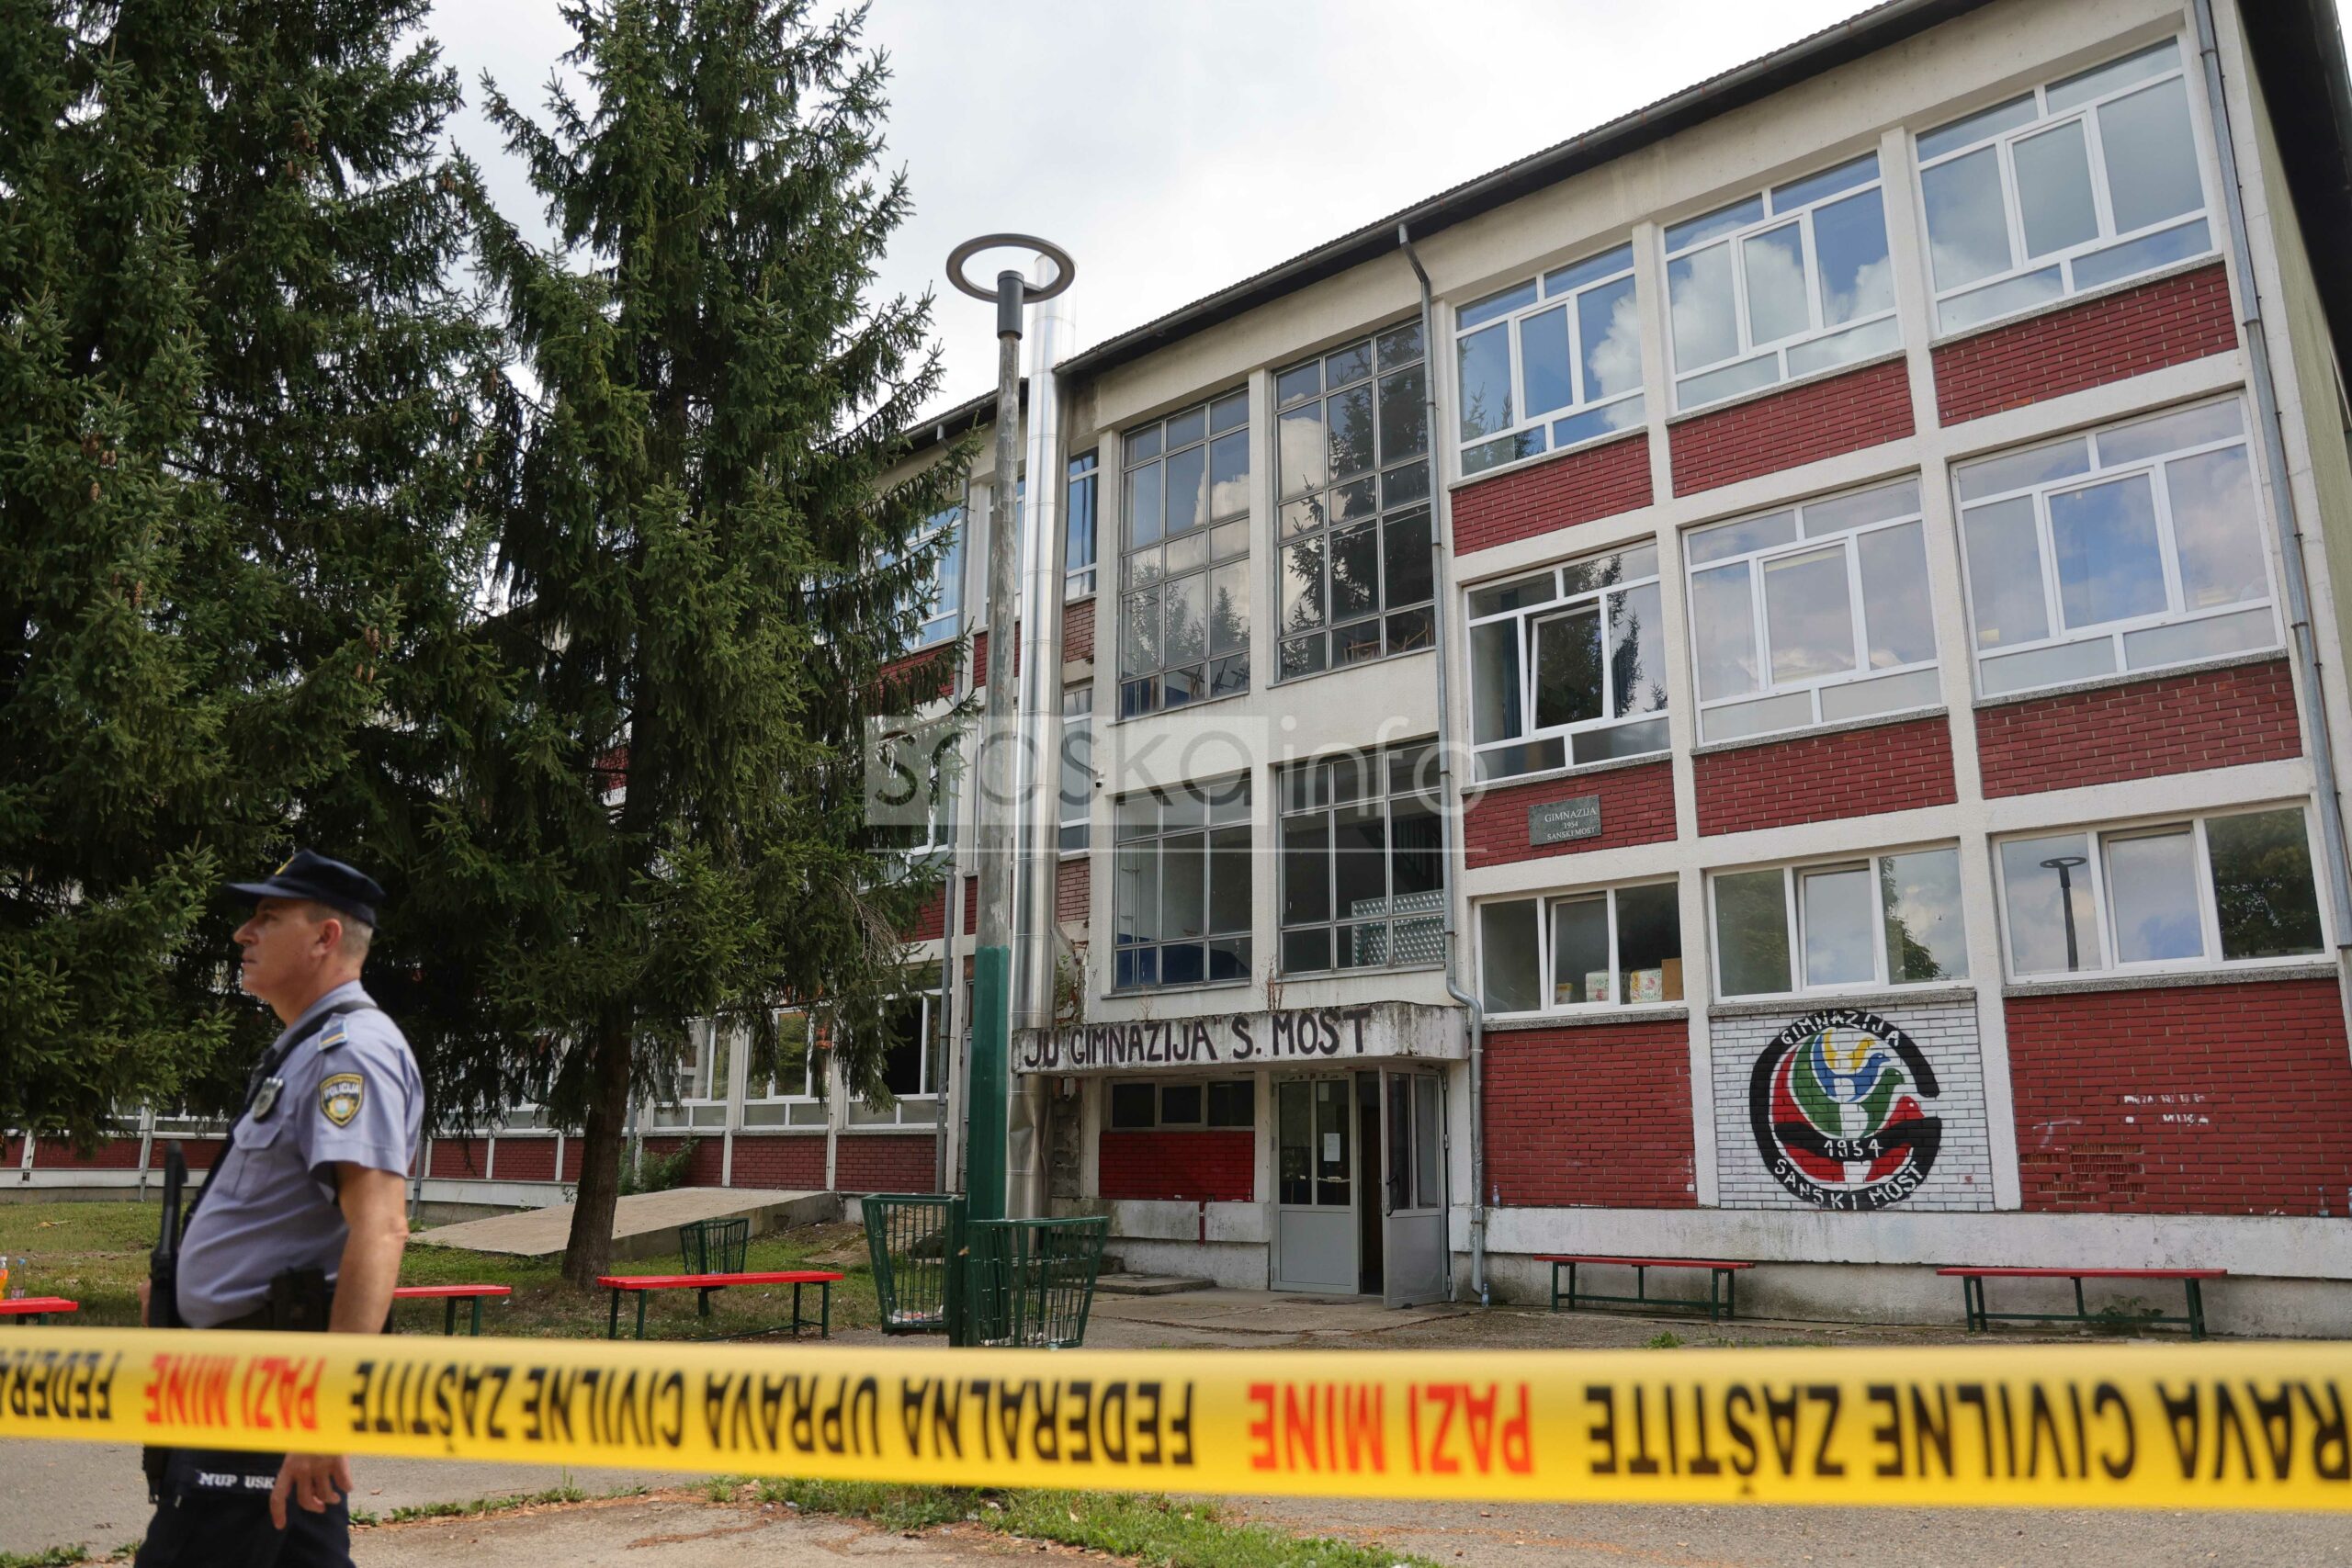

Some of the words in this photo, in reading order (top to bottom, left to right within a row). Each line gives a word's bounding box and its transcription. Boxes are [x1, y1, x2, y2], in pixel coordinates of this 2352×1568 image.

[1544, 807, 1597, 822] GIMNAZIJA
[1546, 829, 1574, 840] SANSKI
[1575, 827, 1596, 836] MOST
[1564, 821, 1578, 829] 1954
[1024, 1030, 1059, 1068] JU
[1231, 1015, 1262, 1060] S.
[1272, 1008, 1373, 1055] MOST
[1781, 1010, 1900, 1047] GIMNAZIJA
[323, 1082, 359, 1100] POLICIJA
[1774, 1158, 1858, 1211] SANSKI
[1868, 1160, 1924, 1206] MOST
[1824, 1138, 1883, 1158] 1954
[144, 1352, 240, 1427] MINE
[240, 1354, 326, 1431] PAZI
[350, 1359, 514, 1452] ZAŠTITE
[525, 1365, 686, 1448] CIVILNE
[704, 1370, 880, 1459] UPRAVA
[901, 1378, 1196, 1467] FEDERALNA
[1247, 1382, 1385, 1472] MINE
[1407, 1382, 1535, 1475] PAZI
[1584, 1383, 1846, 1496] ZAŠTITE
[1866, 1382, 2137, 1481] CIVILNE
[198, 1472, 238, 1487] MUP
